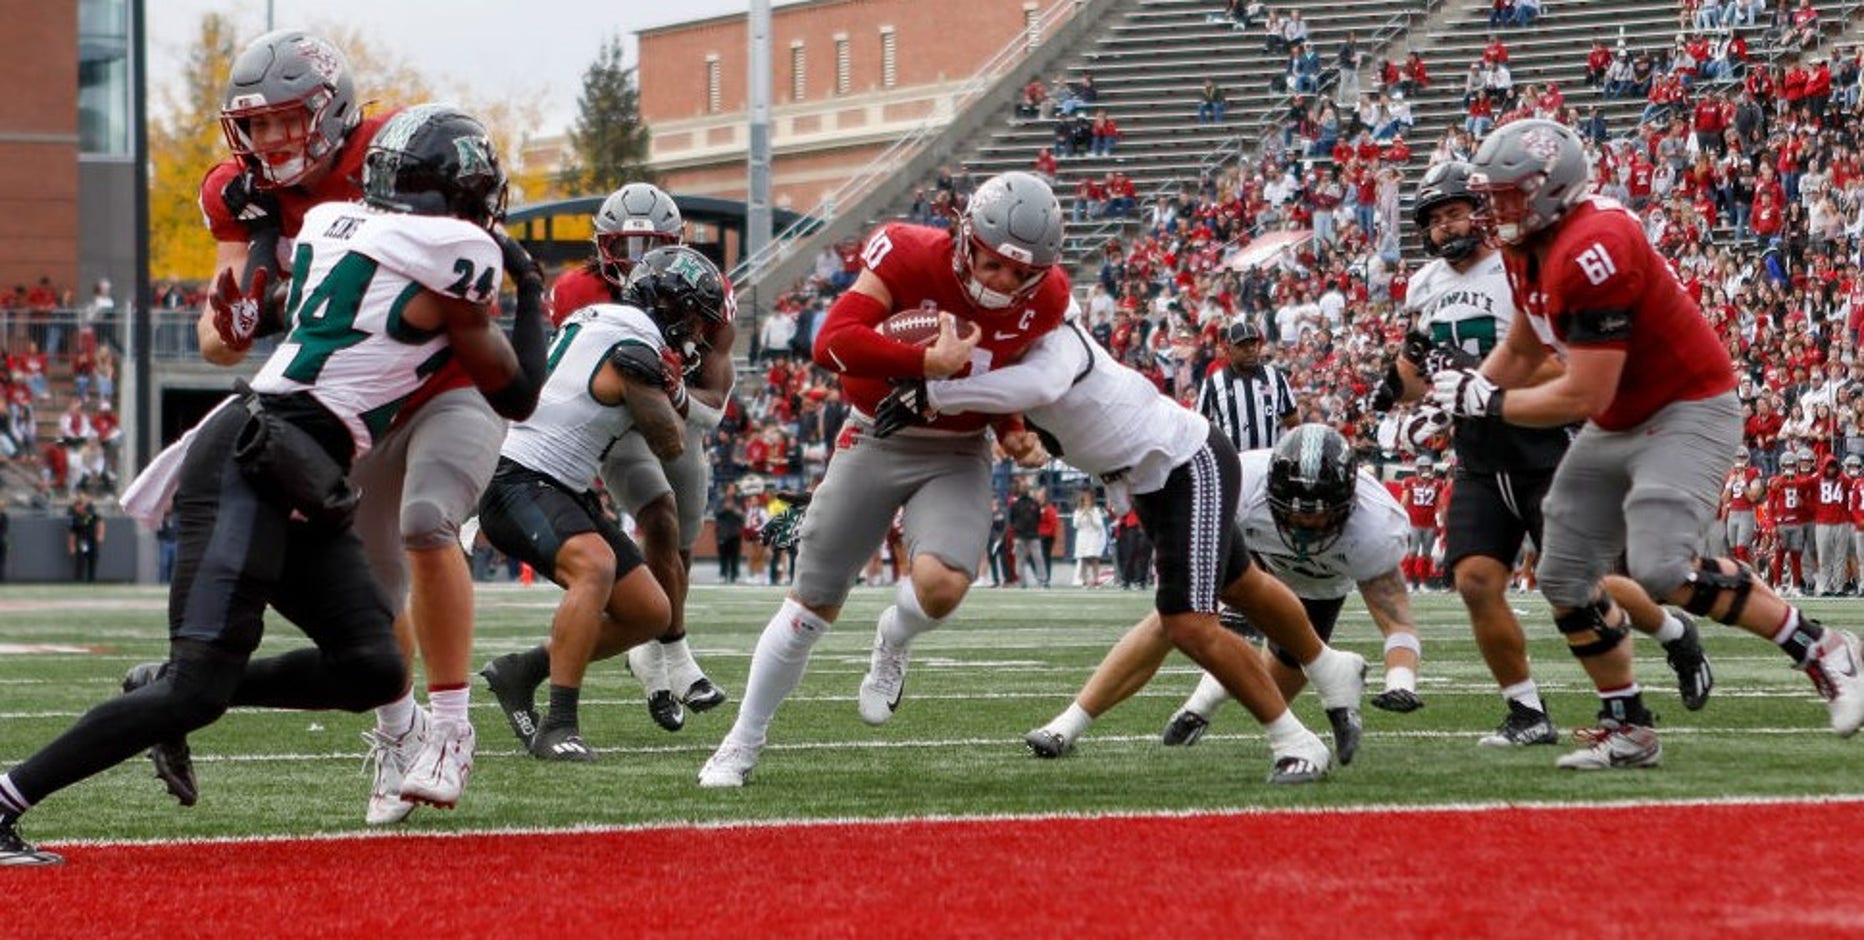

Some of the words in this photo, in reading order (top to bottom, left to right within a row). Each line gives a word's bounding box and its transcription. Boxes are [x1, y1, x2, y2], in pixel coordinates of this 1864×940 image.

[1575, 242, 1616, 286] 61
[443, 257, 495, 300] 24
[1018, 309, 1036, 330] C
[1413, 487, 1436, 506] 52
[1784, 487, 1798, 509] 8
[1820, 481, 1844, 504] 84
